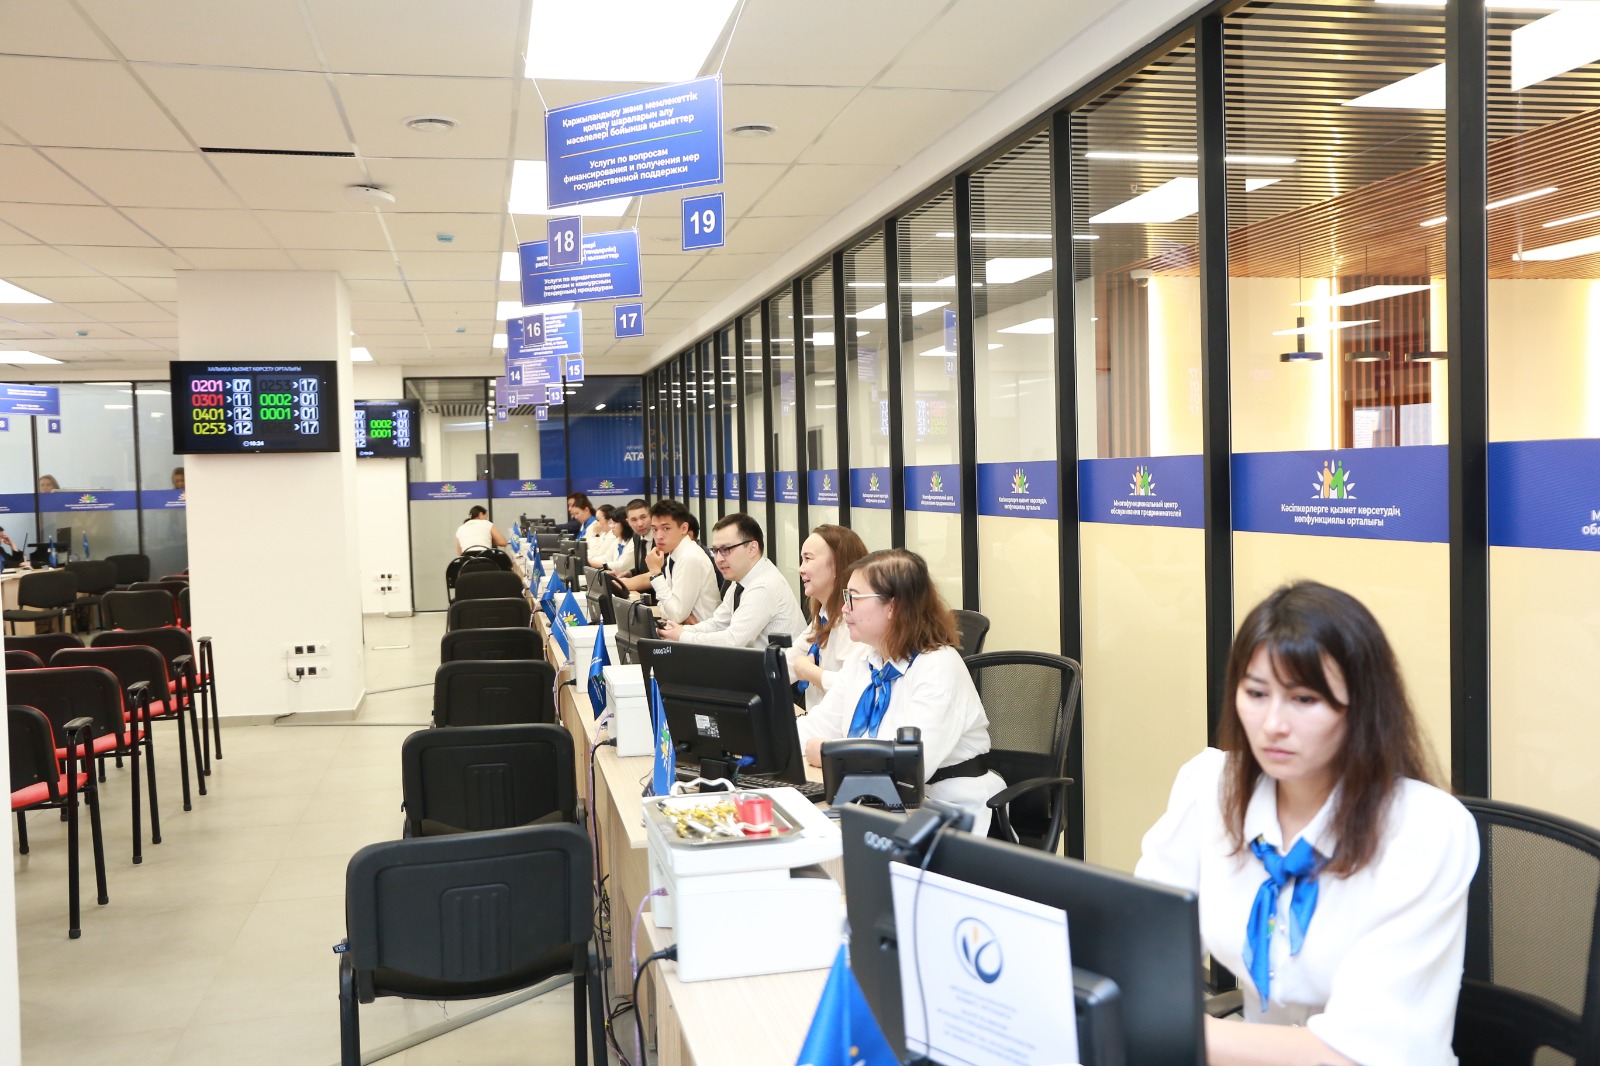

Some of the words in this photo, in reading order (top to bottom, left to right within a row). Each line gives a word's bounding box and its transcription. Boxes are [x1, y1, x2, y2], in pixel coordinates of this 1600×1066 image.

[562, 109, 620, 128] Қаржыландыру
[622, 104, 643, 114] және
[646, 92, 697, 110] мемлекеттік
[583, 121, 609, 133] қолдау
[611, 111, 657, 126] шараларын
[659, 108, 674, 117] алу
[566, 130, 608, 146] мәселелері
[610, 123, 647, 136] бойынша
[649, 114, 694, 129] қызметтер
[590, 158, 615, 168] Услуги
[629, 148, 668, 161] вопросам
[564, 166, 628, 184] финансирования
[636, 156, 680, 170] получения
[682, 153, 699, 162] мер
[574, 172, 638, 191] государственной
[640, 166, 688, 179] поддержки
[690, 209, 716, 235] 19
[554, 230, 574, 253] 18
[620, 313, 637, 329] 17
[527, 322, 540, 338] 16
[510, 371, 520, 381] 14
[569, 365, 580, 376] 15
[191, 380, 223, 392] 0201
[234, 380, 249, 391] 07
[301, 379, 316, 391] 17
[192, 394, 224, 406] 0301
[236, 394, 249, 405] 11
[260, 394, 292, 406] 0002
[301, 394, 315, 405] 01
[551, 392, 560, 400] 13
[192, 408, 224, 420] 0401
[236, 408, 251, 420] 12
[260, 408, 291, 420] 0001
[301, 408, 316, 419] 01
[355, 410, 365, 419] 07
[399, 410, 409, 418] 17
[193, 422, 226, 435] 0253
[236, 422, 252, 434] 12
[302, 422, 317, 433] 17
[355, 420, 364, 428] 11
[370, 420, 392, 428] 0002
[398, 420, 408, 428] 01
[356, 430, 365, 438] 12
[370, 429, 391, 438] 0001
[398, 429, 408, 437] 01
[356, 439, 366, 447] 12
[400, 438, 409, 446] 17
[1281, 503, 1328, 514] Кәсіпкерлерге
[1330, 506, 1356, 514] қызмет
[1358, 505, 1400, 517] көрсетудің
[1294, 514, 1346, 525] көпфункциялы
[1347, 517, 1384, 527] орталығы
